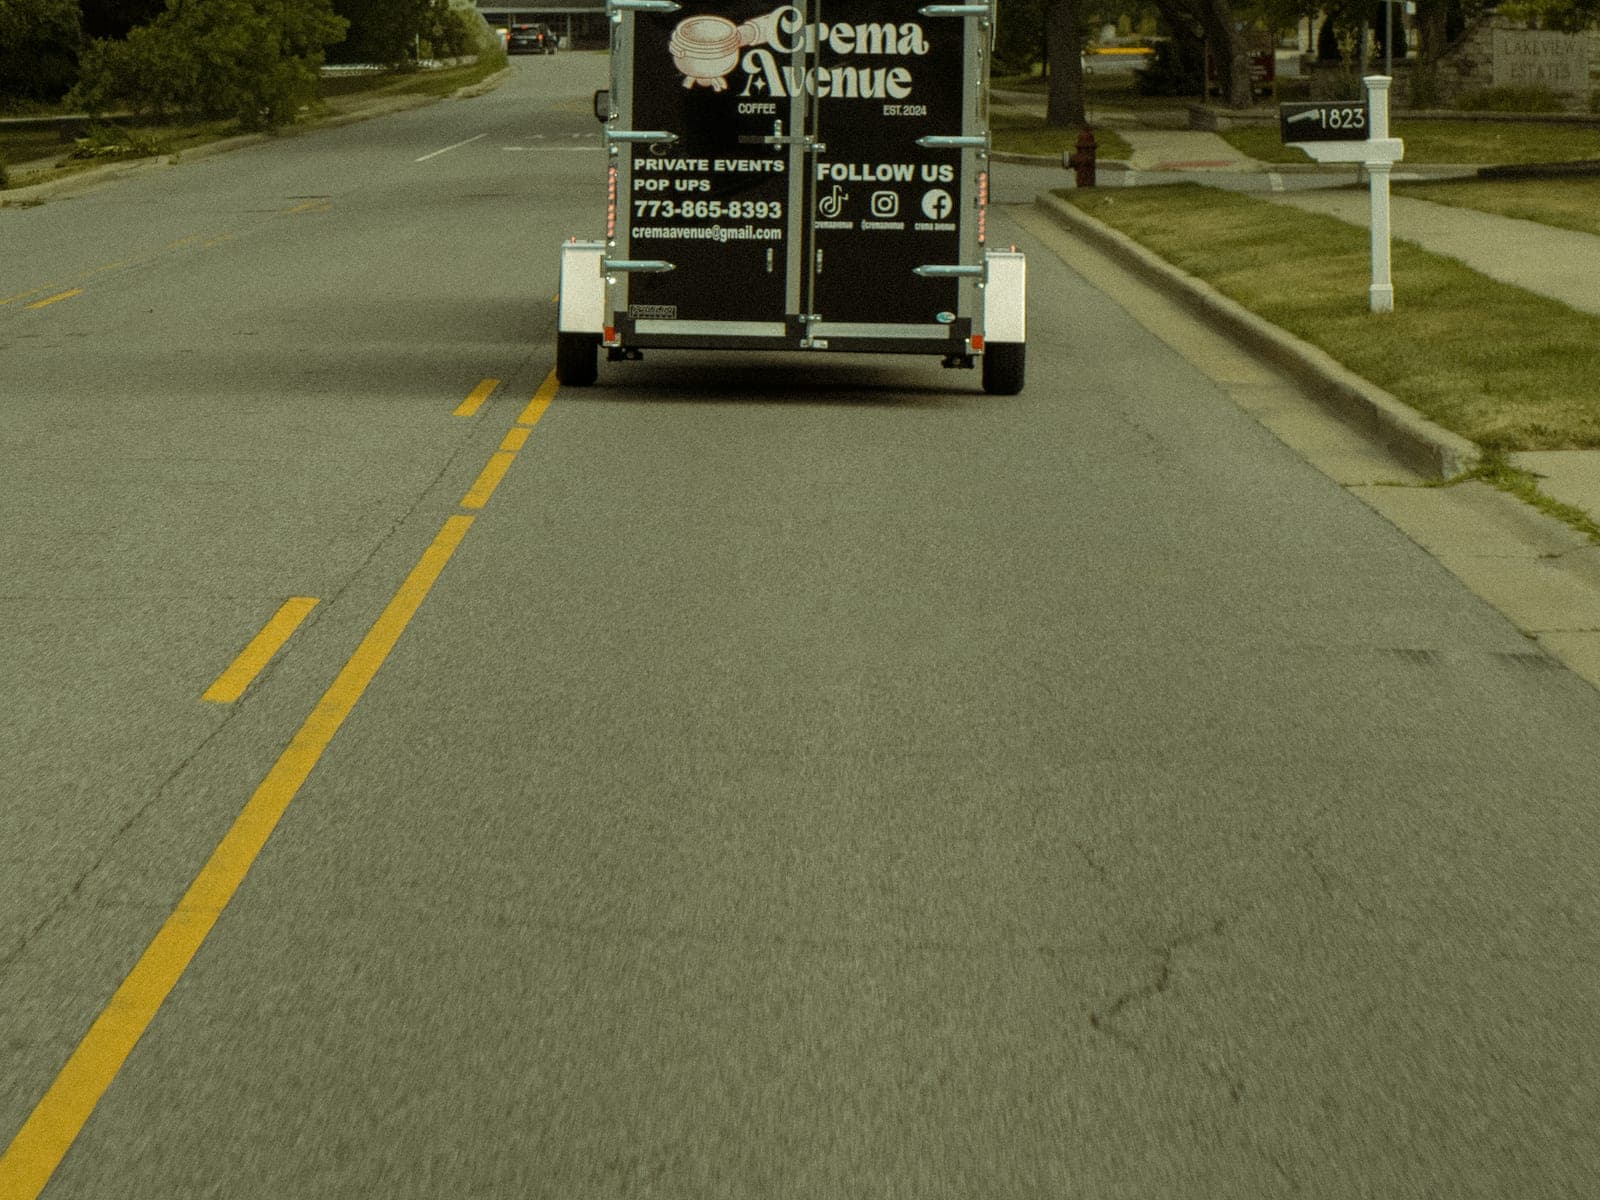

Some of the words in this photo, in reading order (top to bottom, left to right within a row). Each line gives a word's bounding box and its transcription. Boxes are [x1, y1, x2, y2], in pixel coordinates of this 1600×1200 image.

[768, 5, 930, 55] Crema
[1503, 39, 1577, 55] LAKEVIEW
[737, 48, 913, 99] Avenue
[737, 103, 777, 114] COFFEE
[1319, 108, 1365, 129] 1823
[633, 158, 709, 171] PRIVATE
[713, 159, 785, 172] EVENTS
[817, 163, 915, 182] FOLLOW
[921, 164, 954, 182] US
[633, 179, 670, 191] POP
[675, 179, 711, 191] UPS
[634, 200, 782, 218] 773-865-8393
[632, 224, 782, 242] cremaavenue@gmail.com
